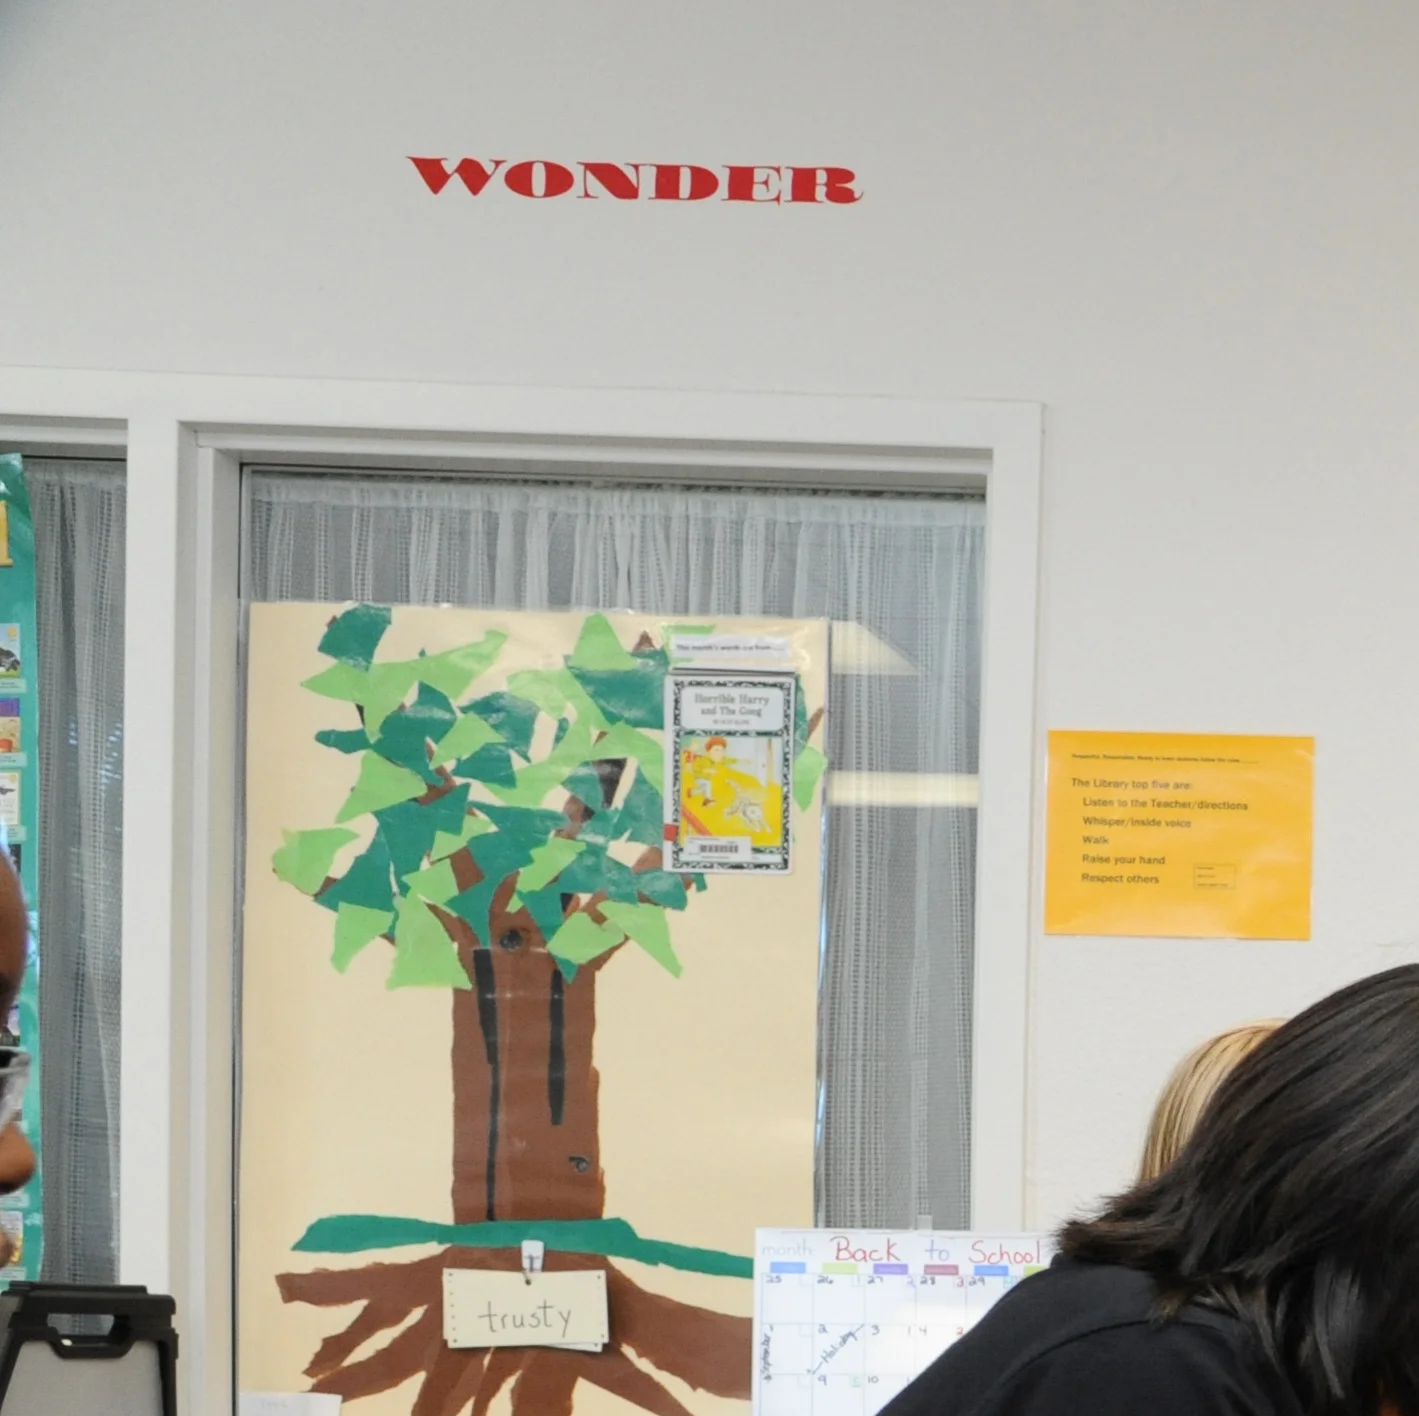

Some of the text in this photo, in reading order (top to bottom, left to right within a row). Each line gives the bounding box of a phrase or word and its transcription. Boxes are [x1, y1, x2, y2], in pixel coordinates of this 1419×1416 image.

[405, 156, 865, 206] WONDER
[739, 694, 770, 706] Harry
[1071, 777, 1090, 788] The
[1093, 778, 1128, 791] Library
[1131, 780, 1148, 791] top
[1151, 780, 1170, 790] five
[1083, 798, 1114, 808] Listen
[1117, 798, 1128, 808] to
[1130, 799, 1147, 809] the
[1165, 818, 1192, 828] voice
[1082, 835, 1109, 845] Walk
[1082, 854, 1166, 867] Raise your hand
[1081, 872, 1160, 885] Respect others
[830, 1235, 901, 1263] Back
[925, 1239, 950, 1261] to
[968, 1240, 1041, 1265] School
[765, 1275, 783, 1284] 25
[477, 1298, 572, 1338] trusty
[871, 1324, 880, 1335] 3
[817, 1374, 879, 1386] 9 10
